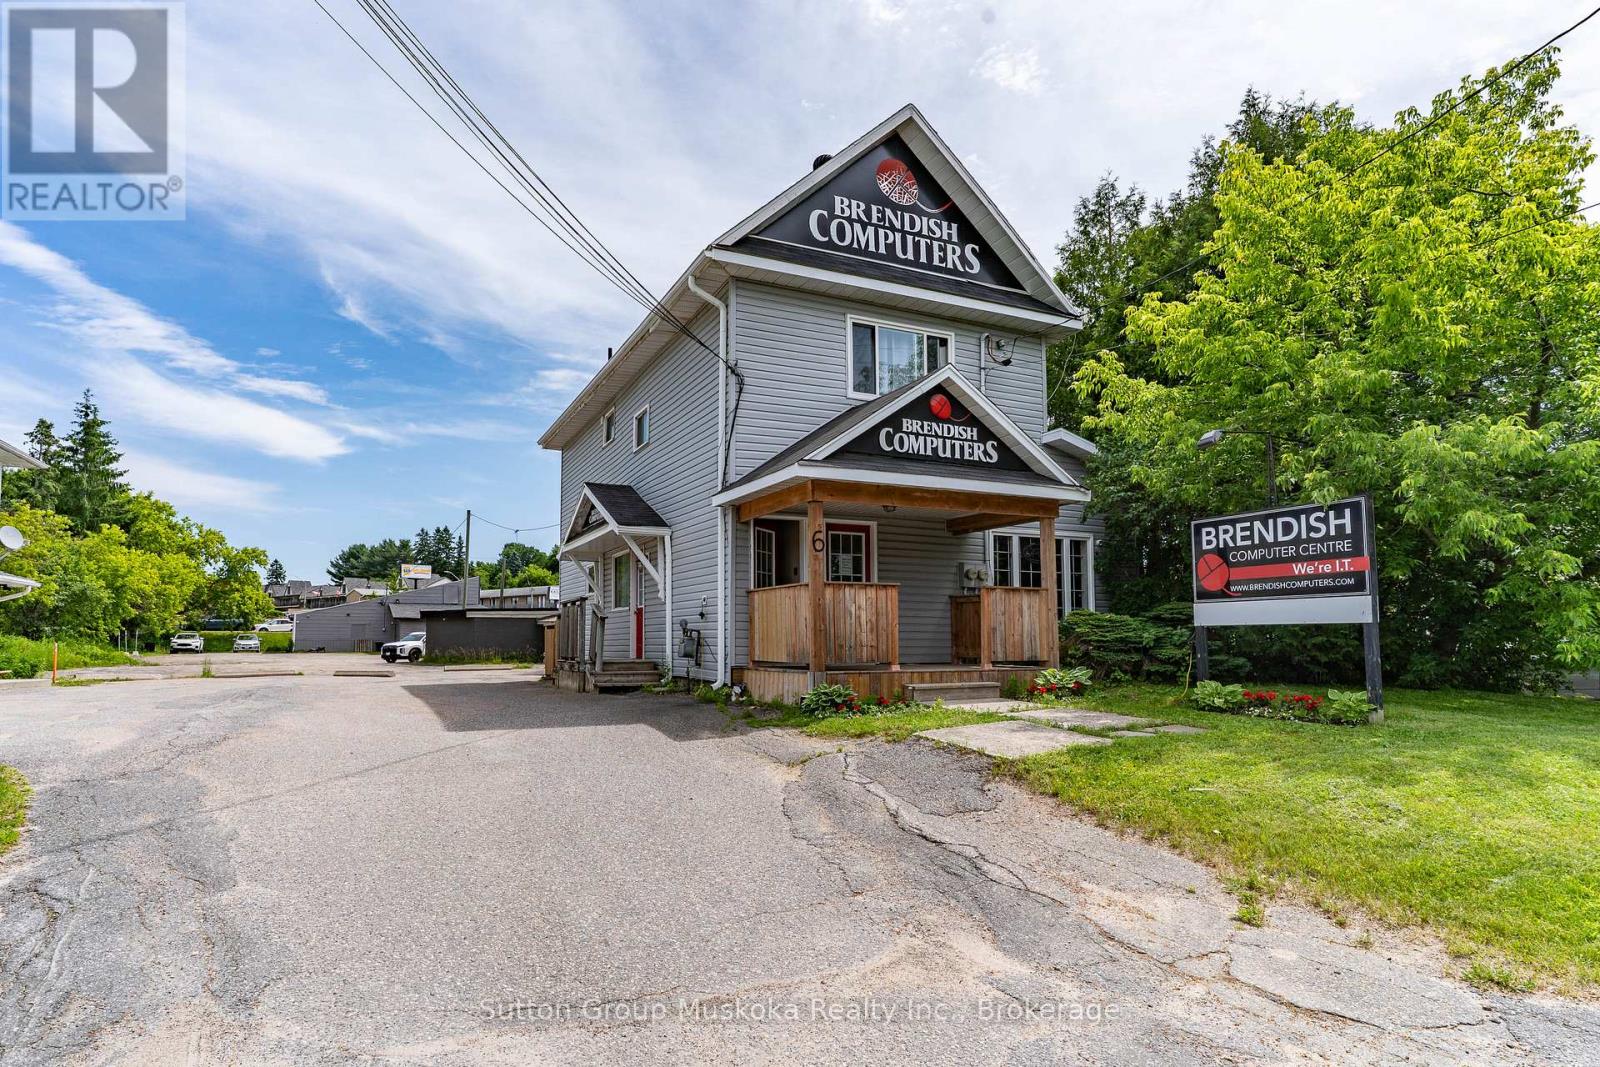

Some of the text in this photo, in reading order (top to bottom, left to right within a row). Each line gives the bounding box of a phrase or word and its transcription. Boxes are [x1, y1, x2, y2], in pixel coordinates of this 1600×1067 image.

[834, 195, 958, 242] BRENDISH
[809, 209, 981, 274] COMPUTERS
[902, 418, 978, 440] BRENDISH
[879, 427, 998, 463] COMPUTERS
[812, 530, 824, 552] 6
[1201, 508, 1351, 550] BRENDISH
[1229, 540, 1353, 562] COMPUTER CENTRE
[1292, 559, 1354, 575] We're I.T.
